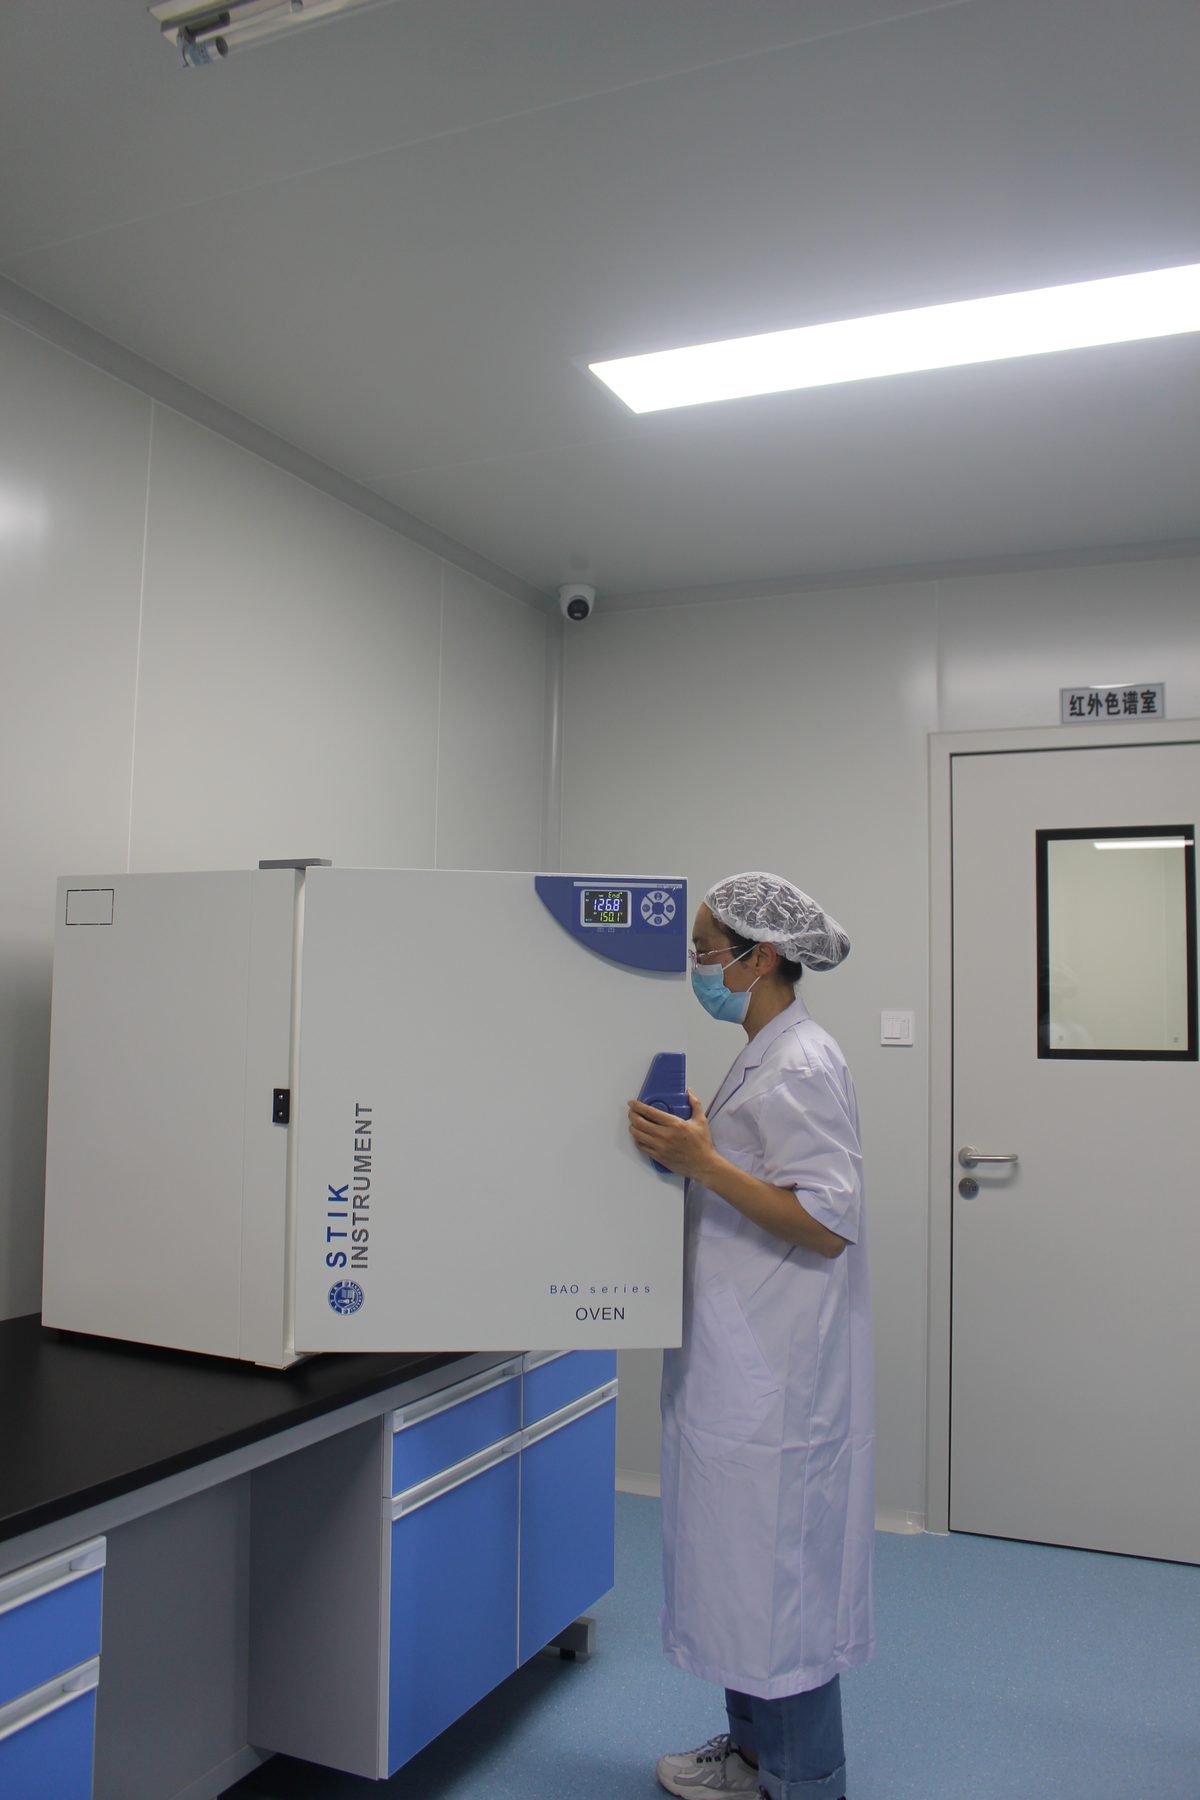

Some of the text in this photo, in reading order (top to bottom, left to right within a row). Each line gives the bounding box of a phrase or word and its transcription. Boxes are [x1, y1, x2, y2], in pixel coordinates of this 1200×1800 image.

[1069, 690, 1157, 716] 红外色谱室
[351, 1103, 372, 1268] INSTRUMENT
[326, 1184, 349, 1268] STIK
[549, 1284, 650, 1294] BAO series
[575, 1307, 625, 1320] OVEN
